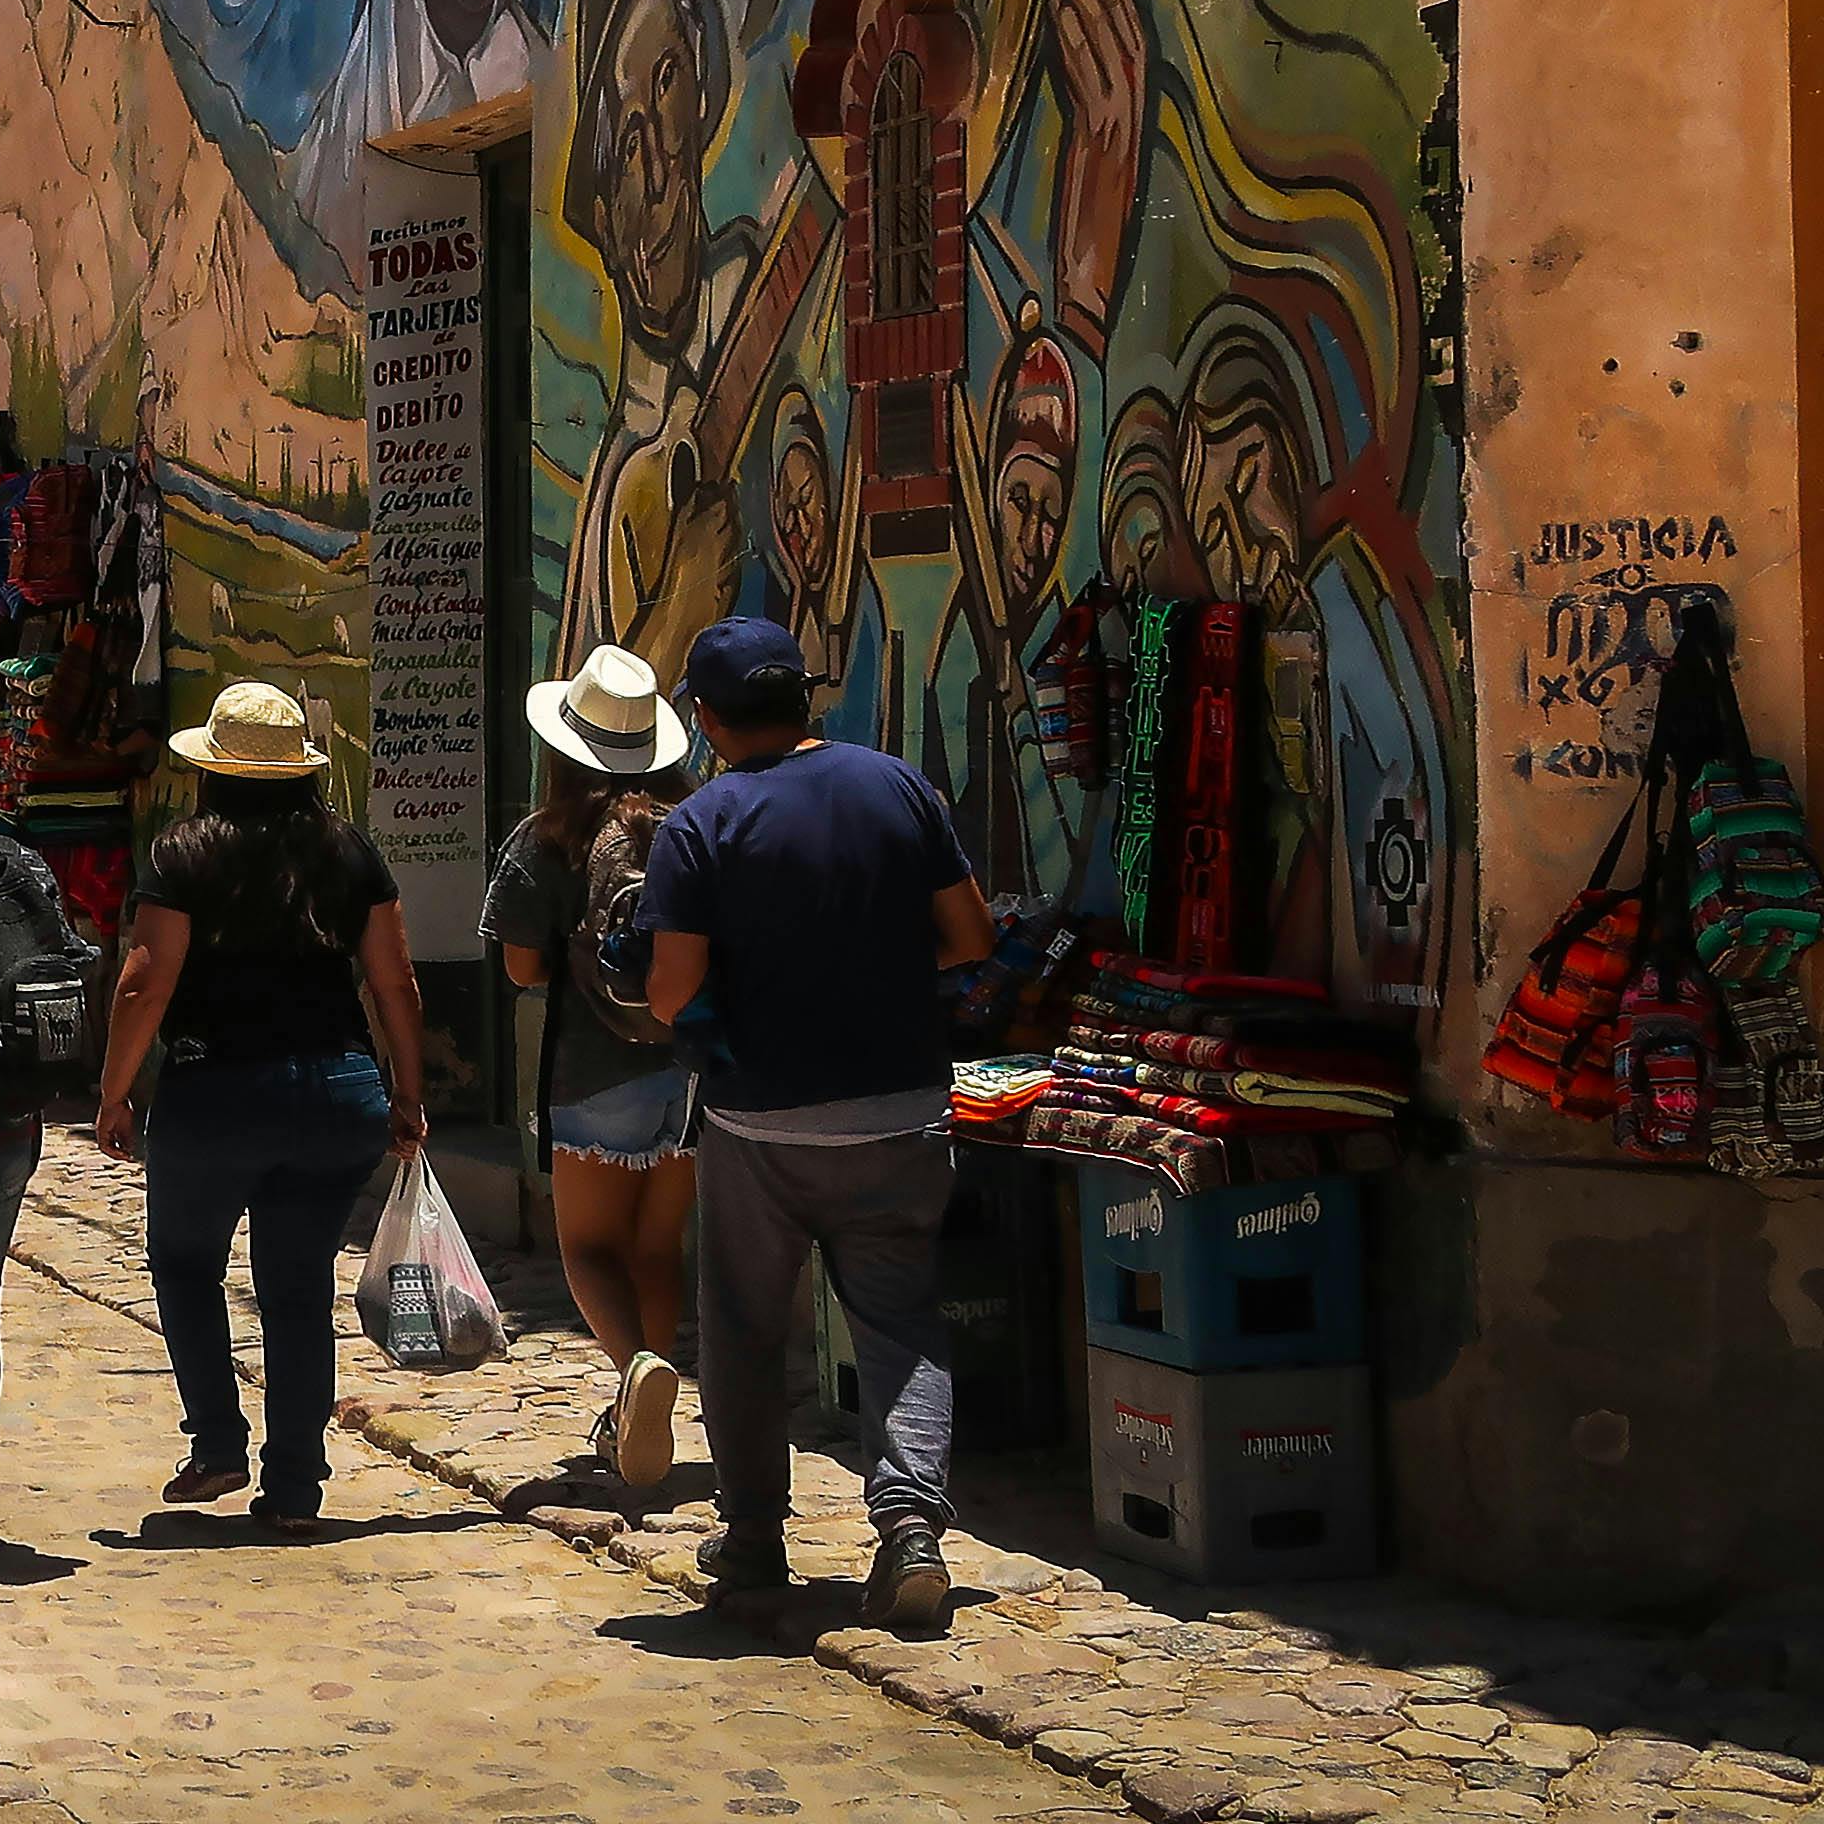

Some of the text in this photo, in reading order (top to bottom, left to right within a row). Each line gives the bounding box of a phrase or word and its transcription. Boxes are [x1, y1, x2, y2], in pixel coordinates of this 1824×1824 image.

[368, 232, 477, 287] TODAS
[368, 295, 479, 341] TARJETAS
[373, 347, 472, 387] CREDITO
[376, 392, 463, 433] DEBITO
[376, 439, 448, 464] Dulce
[378, 463, 464, 494] Cayote
[1531, 515, 1739, 566] JUSTICIA
[371, 621, 415, 644] Miel
[416, 620, 437, 642] de
[401, 674, 477, 707] Cayote
[373, 708, 481, 734] Bombon de
[371, 734, 428, 766] Cayote
[1105, 1187, 1164, 1241] Quilmes
[1235, 1191, 1321, 1240] Quilmes
[1240, 1432, 1333, 1458] Schneider
